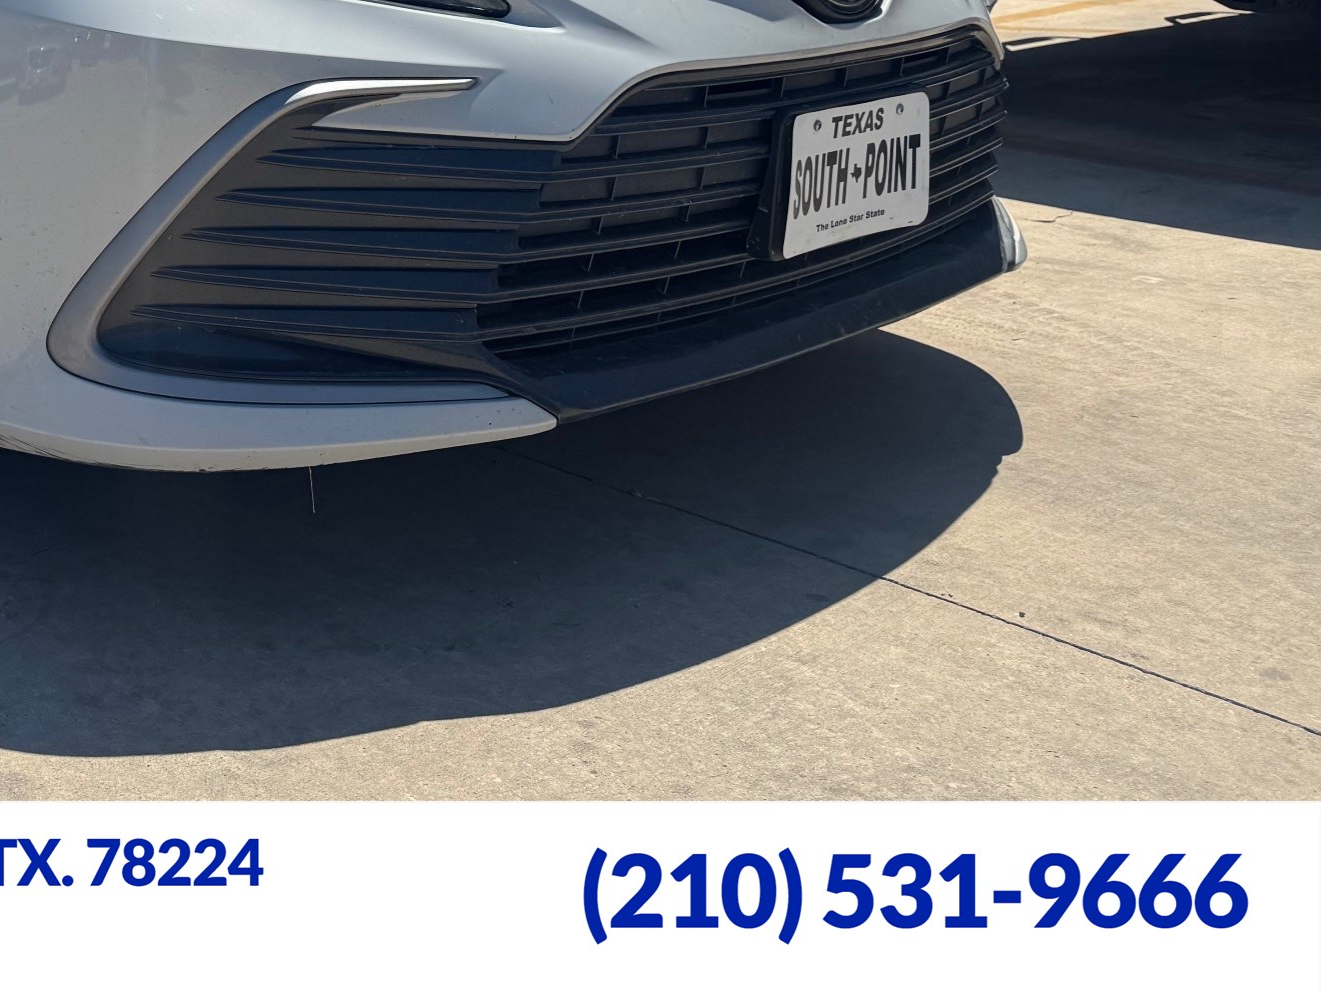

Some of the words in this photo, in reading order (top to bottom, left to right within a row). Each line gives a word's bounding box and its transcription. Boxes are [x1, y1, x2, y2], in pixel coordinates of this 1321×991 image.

[831, 107, 884, 139] TEXAS
[793, 148, 850, 220] SOUTH
[862, 133, 921, 199] POINT
[816, 222, 829, 233] The
[830, 217, 847, 229] Lone
[849, 213, 864, 226] Star
[865, 209, 885, 220] State
